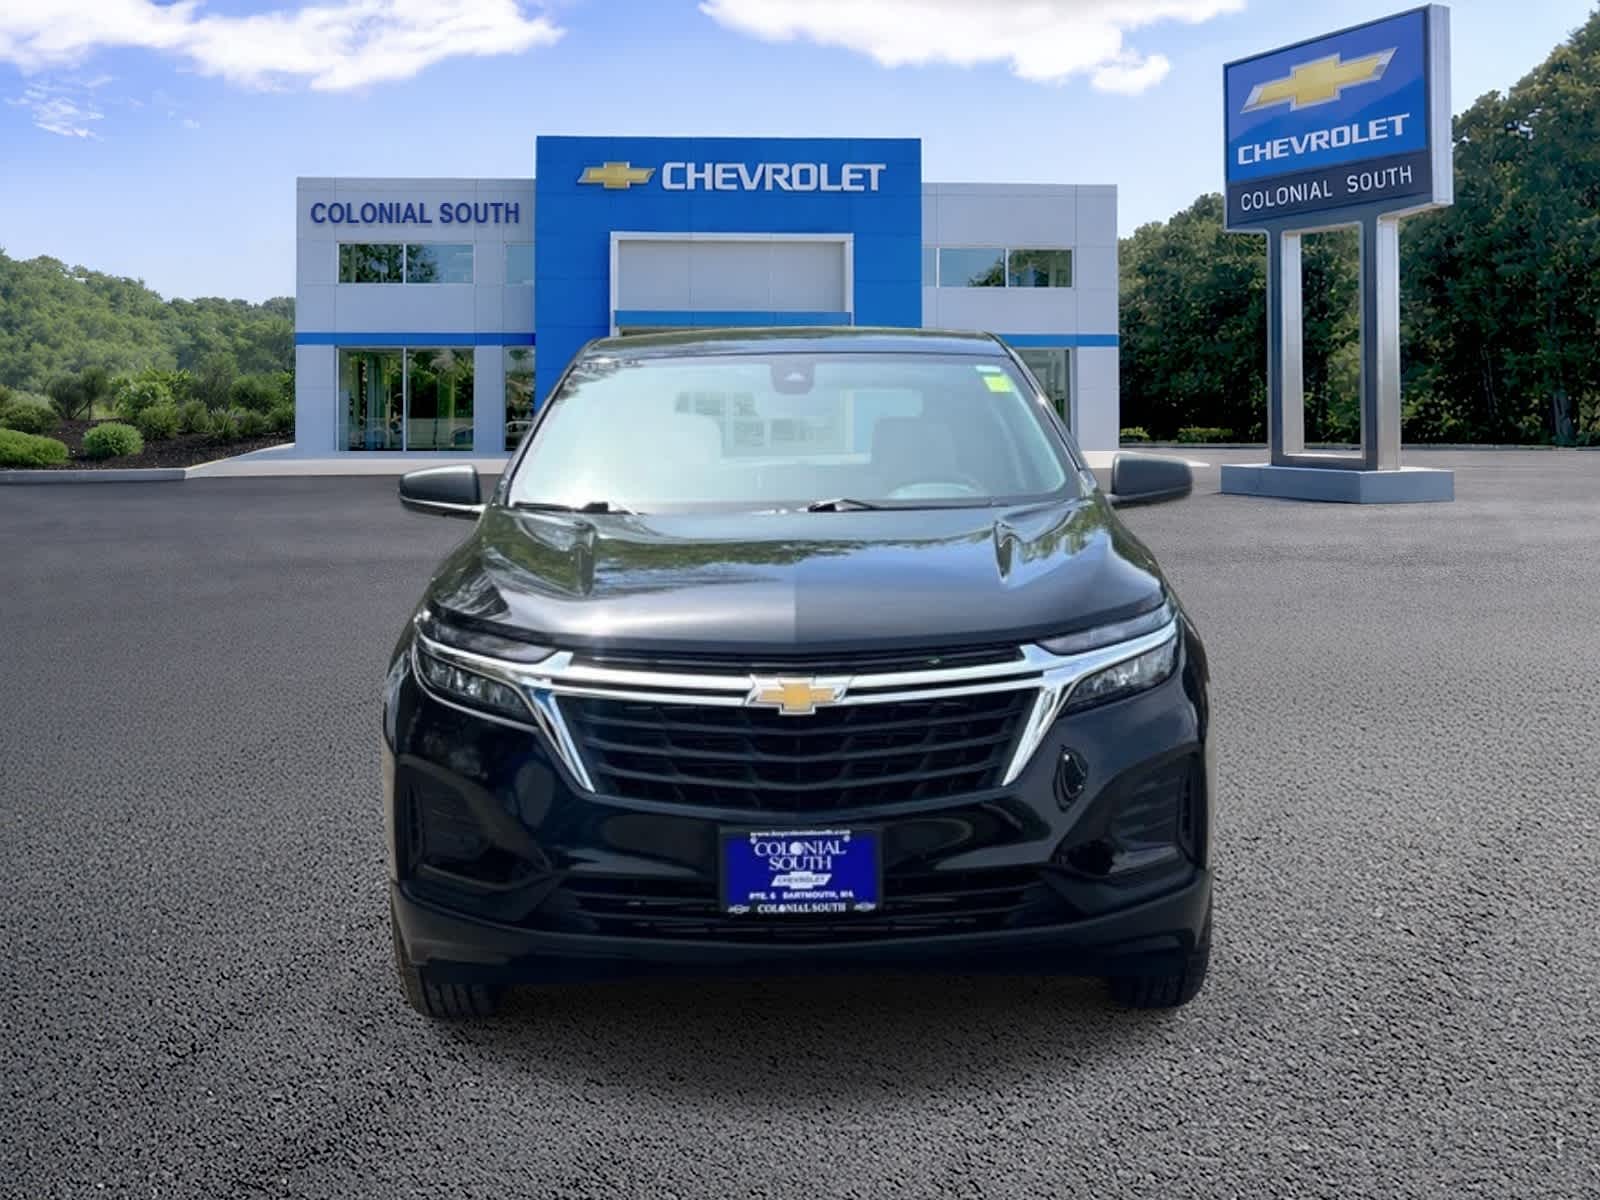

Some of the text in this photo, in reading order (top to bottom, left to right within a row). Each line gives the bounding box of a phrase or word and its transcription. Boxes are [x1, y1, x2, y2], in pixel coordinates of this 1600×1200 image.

[1237, 113, 1410, 165] CHEVROLET
[662, 161, 887, 192] CHEVROLET
[1240, 164, 1413, 212] COLONIAL SOUTH
[310, 202, 520, 224] COLONIAL SOUTH
[754, 840, 847, 856] COLONIAL
[769, 855, 832, 871] SOUTH
[757, 902, 846, 913] COLONIAL SOUTH
